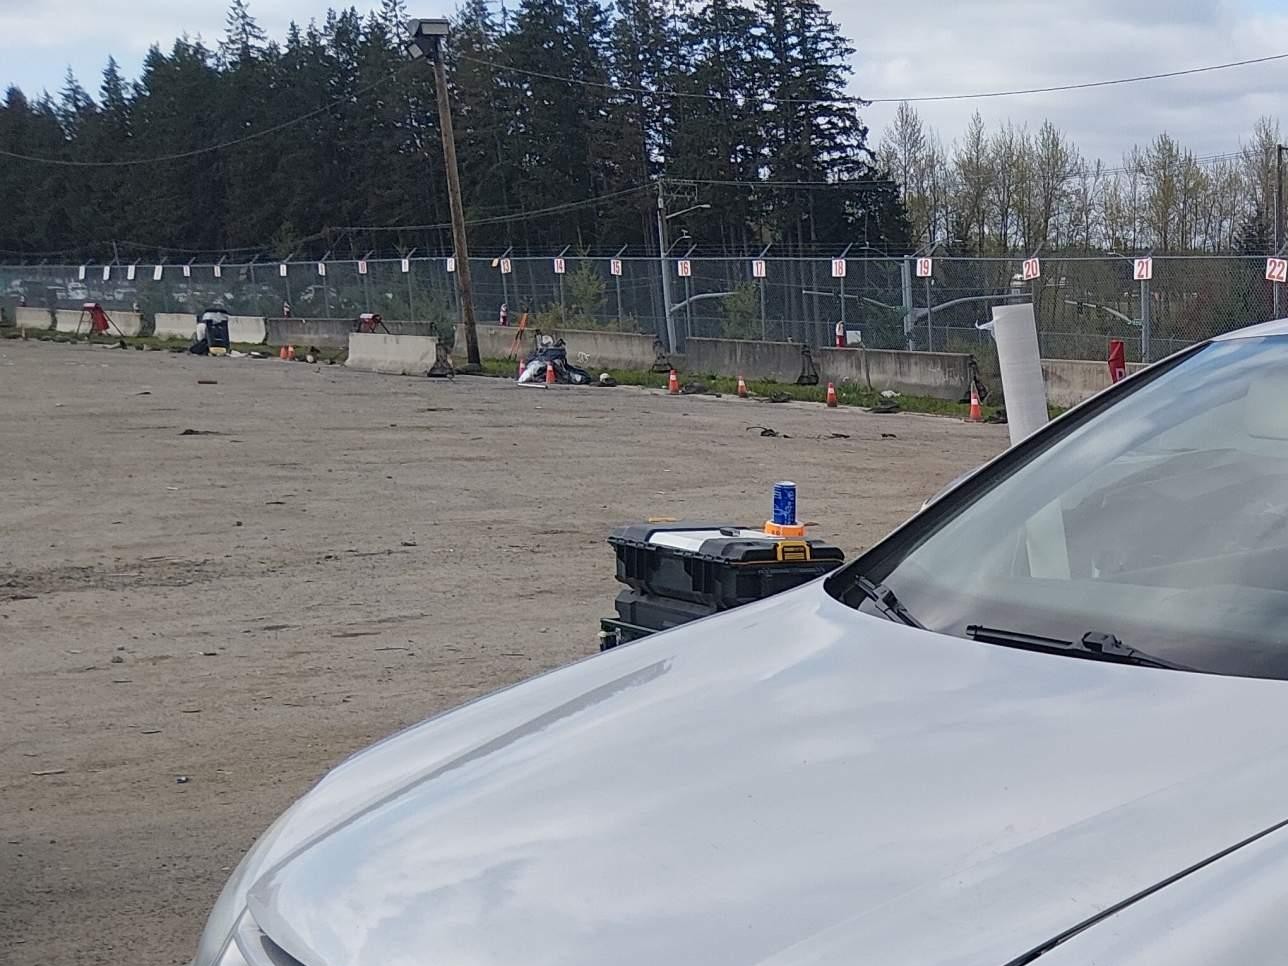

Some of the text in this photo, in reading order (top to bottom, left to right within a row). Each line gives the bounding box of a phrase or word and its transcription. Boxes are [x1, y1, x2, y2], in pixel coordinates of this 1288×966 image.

[555, 260, 564, 272] 14
[612, 261, 621, 273] 15
[680, 262, 689, 275] 16
[754, 262, 764, 275] 17
[834, 261, 844, 275] 18
[919, 261, 929, 275] 19
[1025, 261, 1039, 278] 20
[1137, 261, 1149, 278] 21
[1267, 260, 1285, 280] 22
